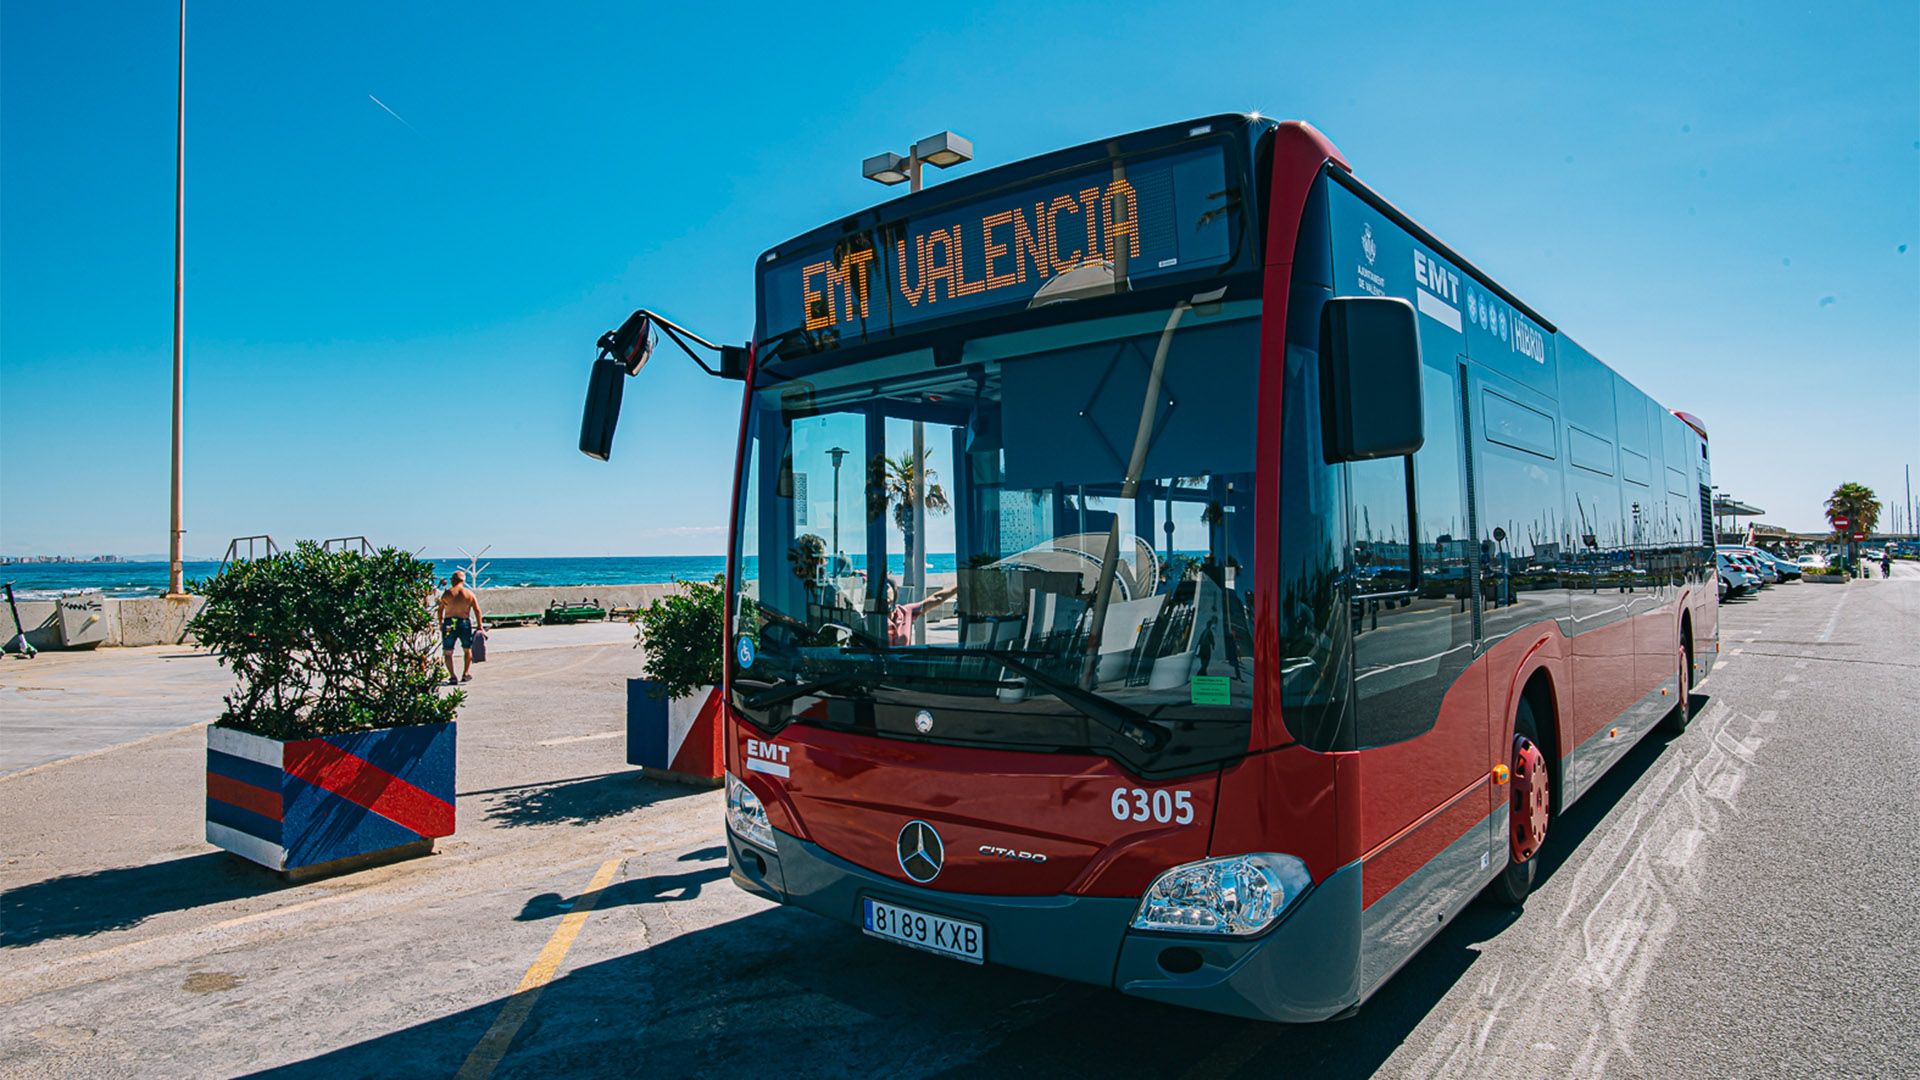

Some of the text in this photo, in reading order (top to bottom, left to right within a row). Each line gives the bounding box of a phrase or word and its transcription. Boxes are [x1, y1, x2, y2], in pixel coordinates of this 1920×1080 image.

[802, 178, 1140, 331] EMT VALENCIA
[1413, 248, 1459, 304] EMT
[747, 738, 790, 763] EMT
[1111, 787, 1194, 825] 6305
[978, 844, 1048, 864] CITARO
[876, 906, 978, 954] 8189 KXB
